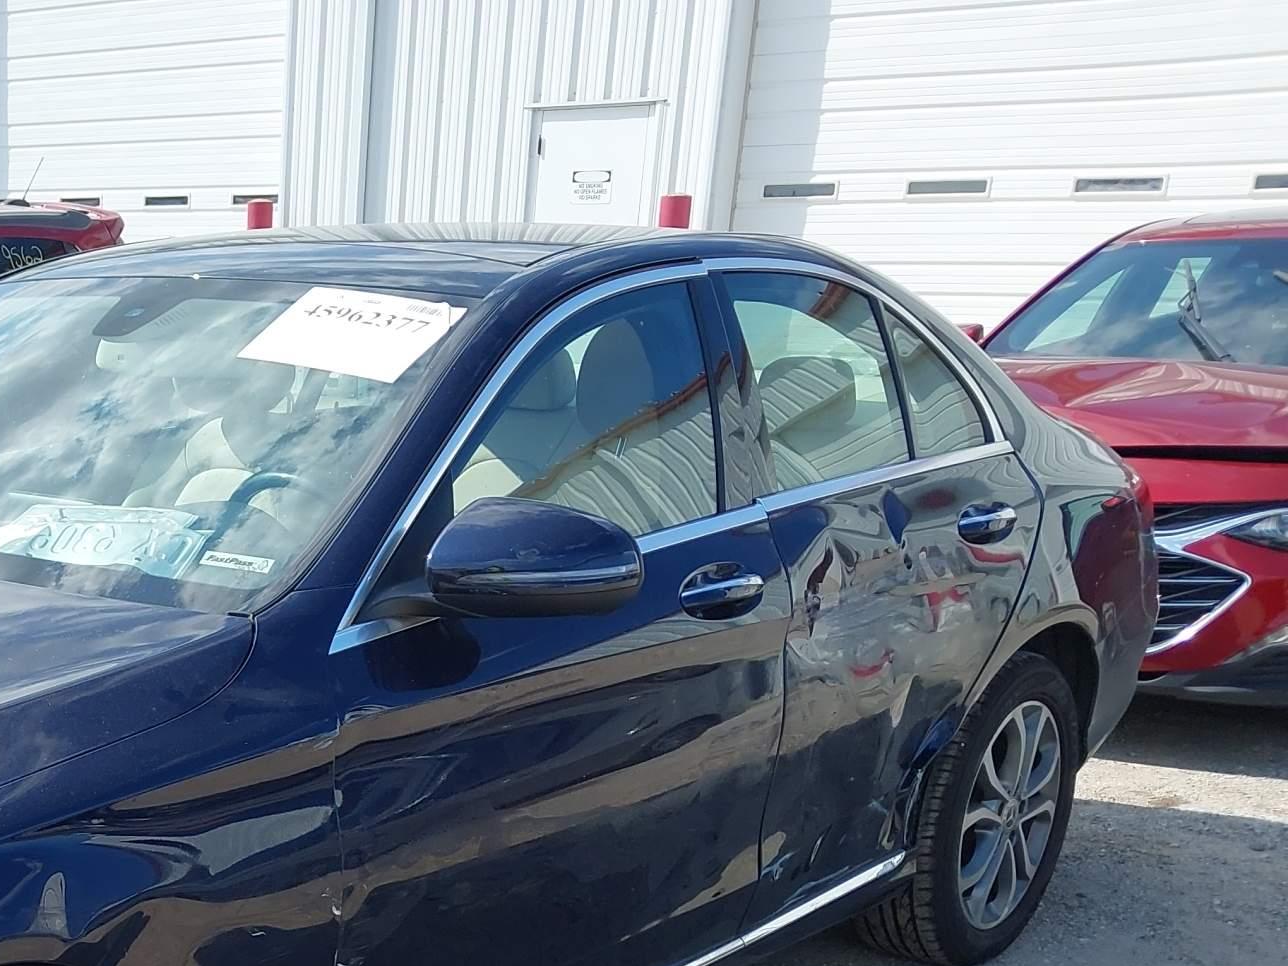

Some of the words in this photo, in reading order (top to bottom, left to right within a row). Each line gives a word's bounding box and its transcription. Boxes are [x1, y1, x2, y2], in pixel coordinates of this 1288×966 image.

[0, 244, 43, 270] 9562
[304, 304, 431, 333] 45962377
[206, 554, 254, 567] FastPass
